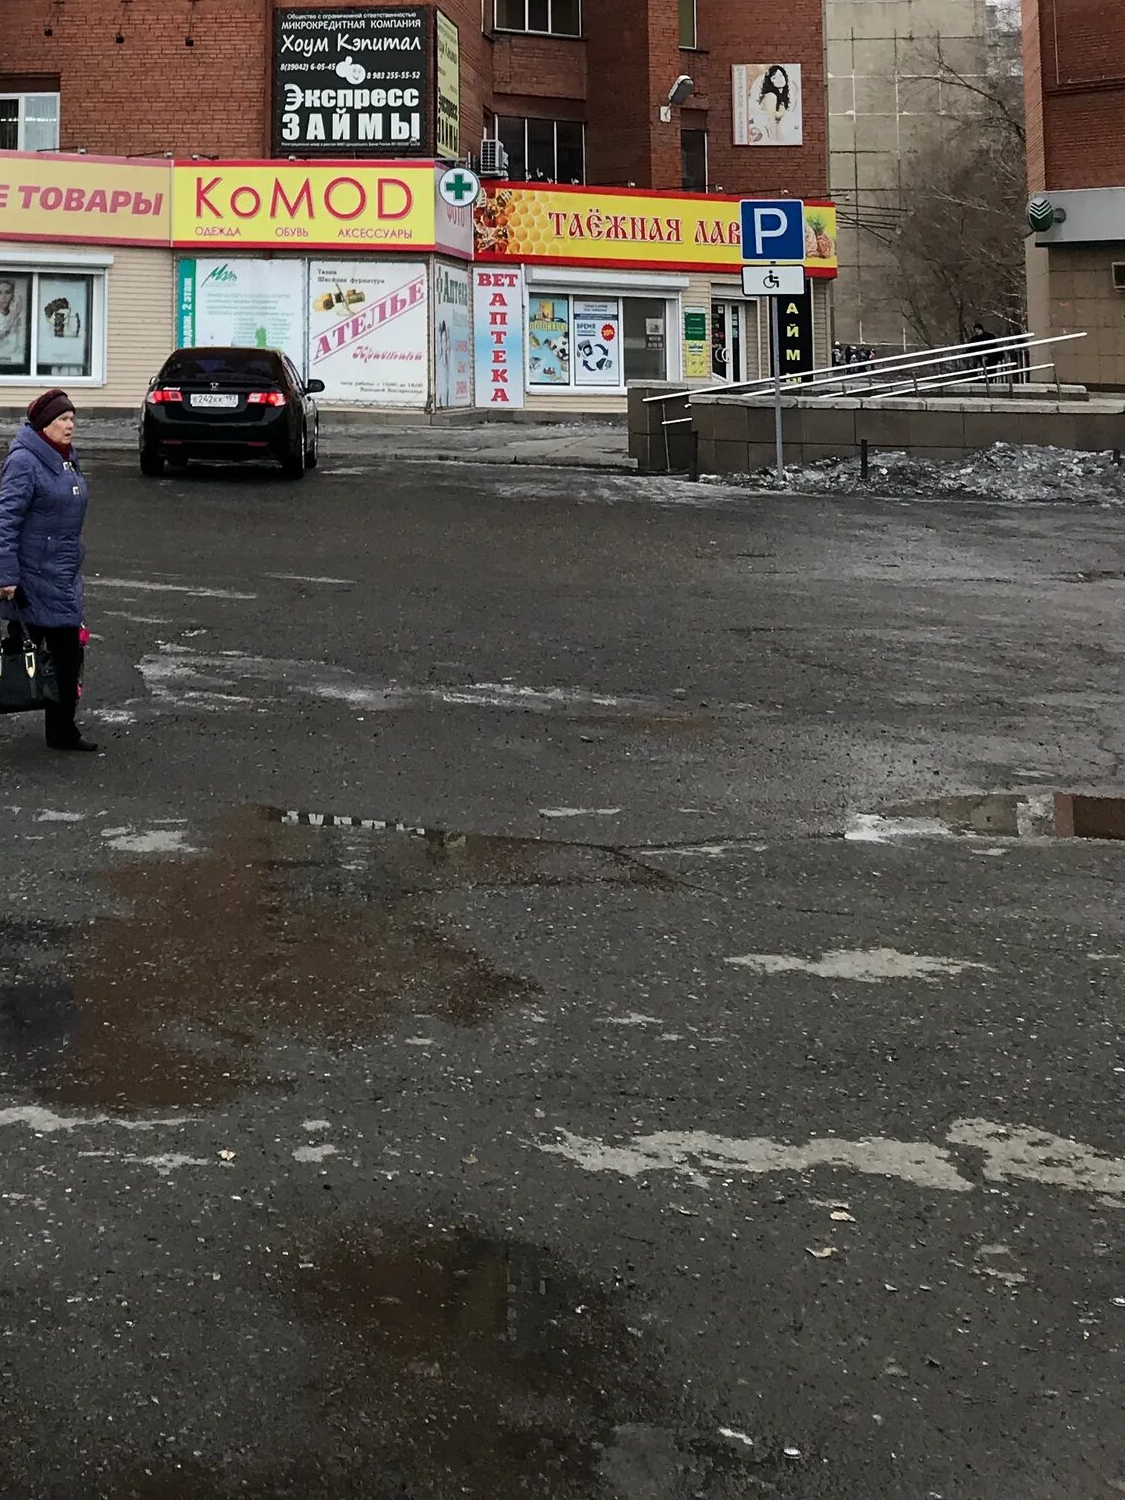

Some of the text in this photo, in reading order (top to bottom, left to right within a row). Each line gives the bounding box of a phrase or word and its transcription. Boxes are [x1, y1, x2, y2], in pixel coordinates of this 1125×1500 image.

[281, 18, 422, 31] МИКРОКРЕДИТНАЯ КОМПАНИЯ
[280, 32, 421, 57] Хоум Кэпитал
[310, 63, 336, 71] 6-05-45
[284, 84, 420, 111] Экспресс
[282, 108, 420, 140] ЗАЙМЫ
[18, 184, 163, 217] ТОВАРЫ
[195, 176, 414, 220] KoMOD
[194, 226, 413, 239] ОДЕЖДА ОБУВЬ АКСЕССУАРЫ
[548, 208, 741, 246] ТАЁЖНАЯ ЛАВ
[753, 207, 788, 255] P
[477, 273, 518, 287] ВЕТ
[313, 278, 425, 360] АТЕЛЬЕ
[489, 292, 510, 403] АПТЕКА
